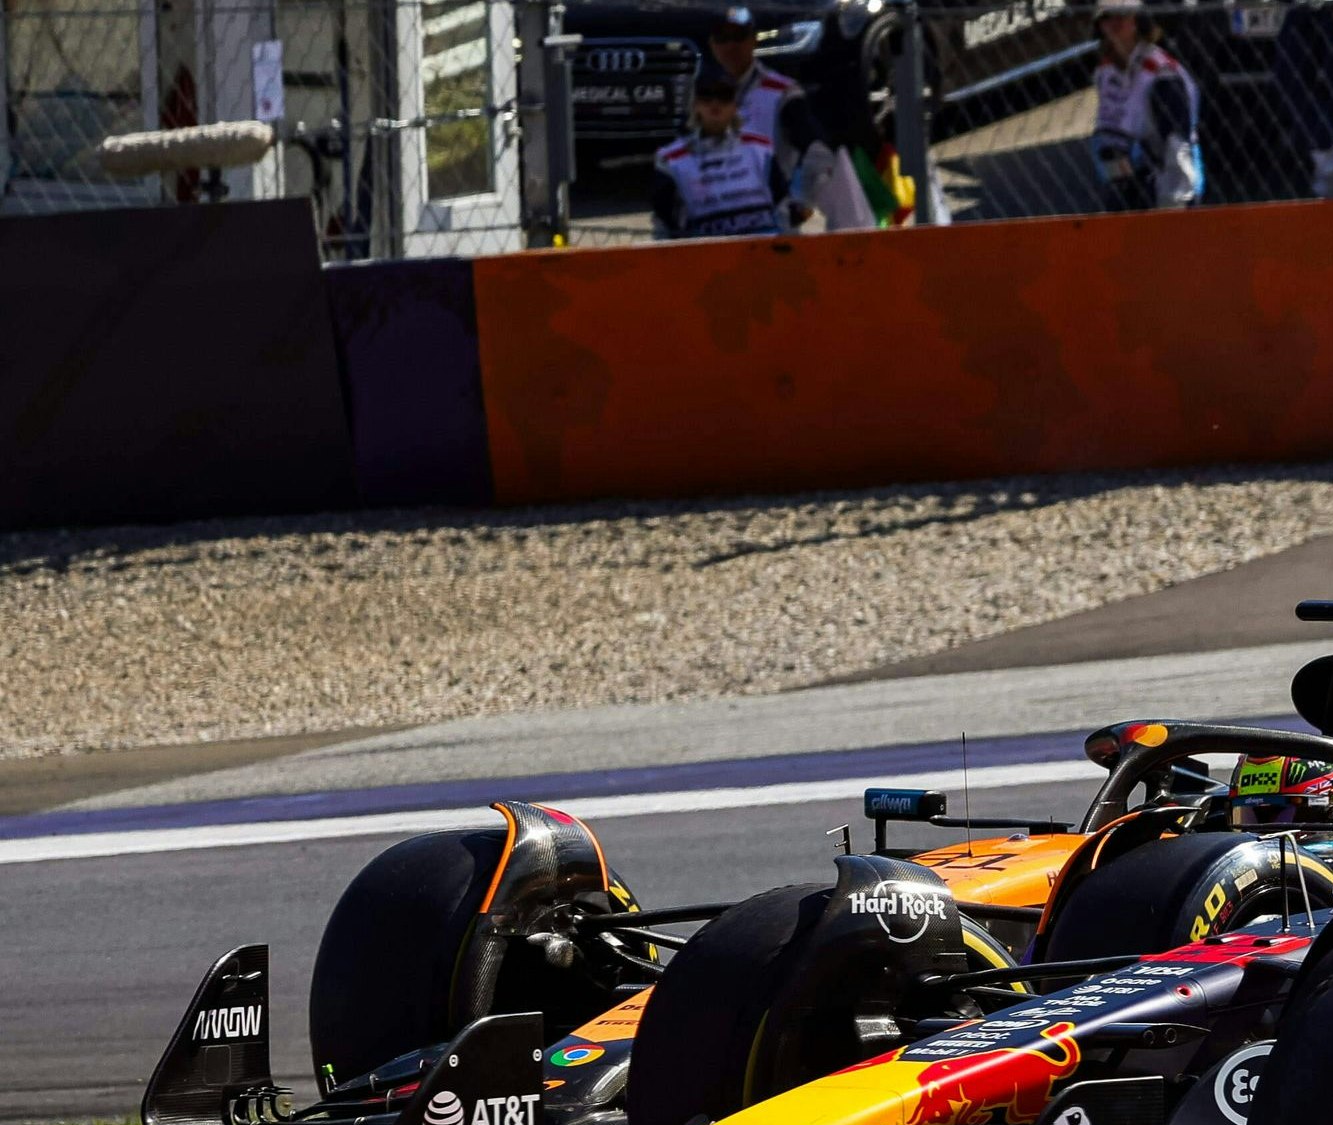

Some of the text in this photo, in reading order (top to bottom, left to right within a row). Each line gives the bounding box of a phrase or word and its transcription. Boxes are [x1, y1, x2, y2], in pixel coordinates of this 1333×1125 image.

[634, 85, 666, 100] CAR
[1241, 772, 1278, 787] OKX
[848, 892, 948, 920] Hard Rock
[1133, 965, 1195, 976] VISA
